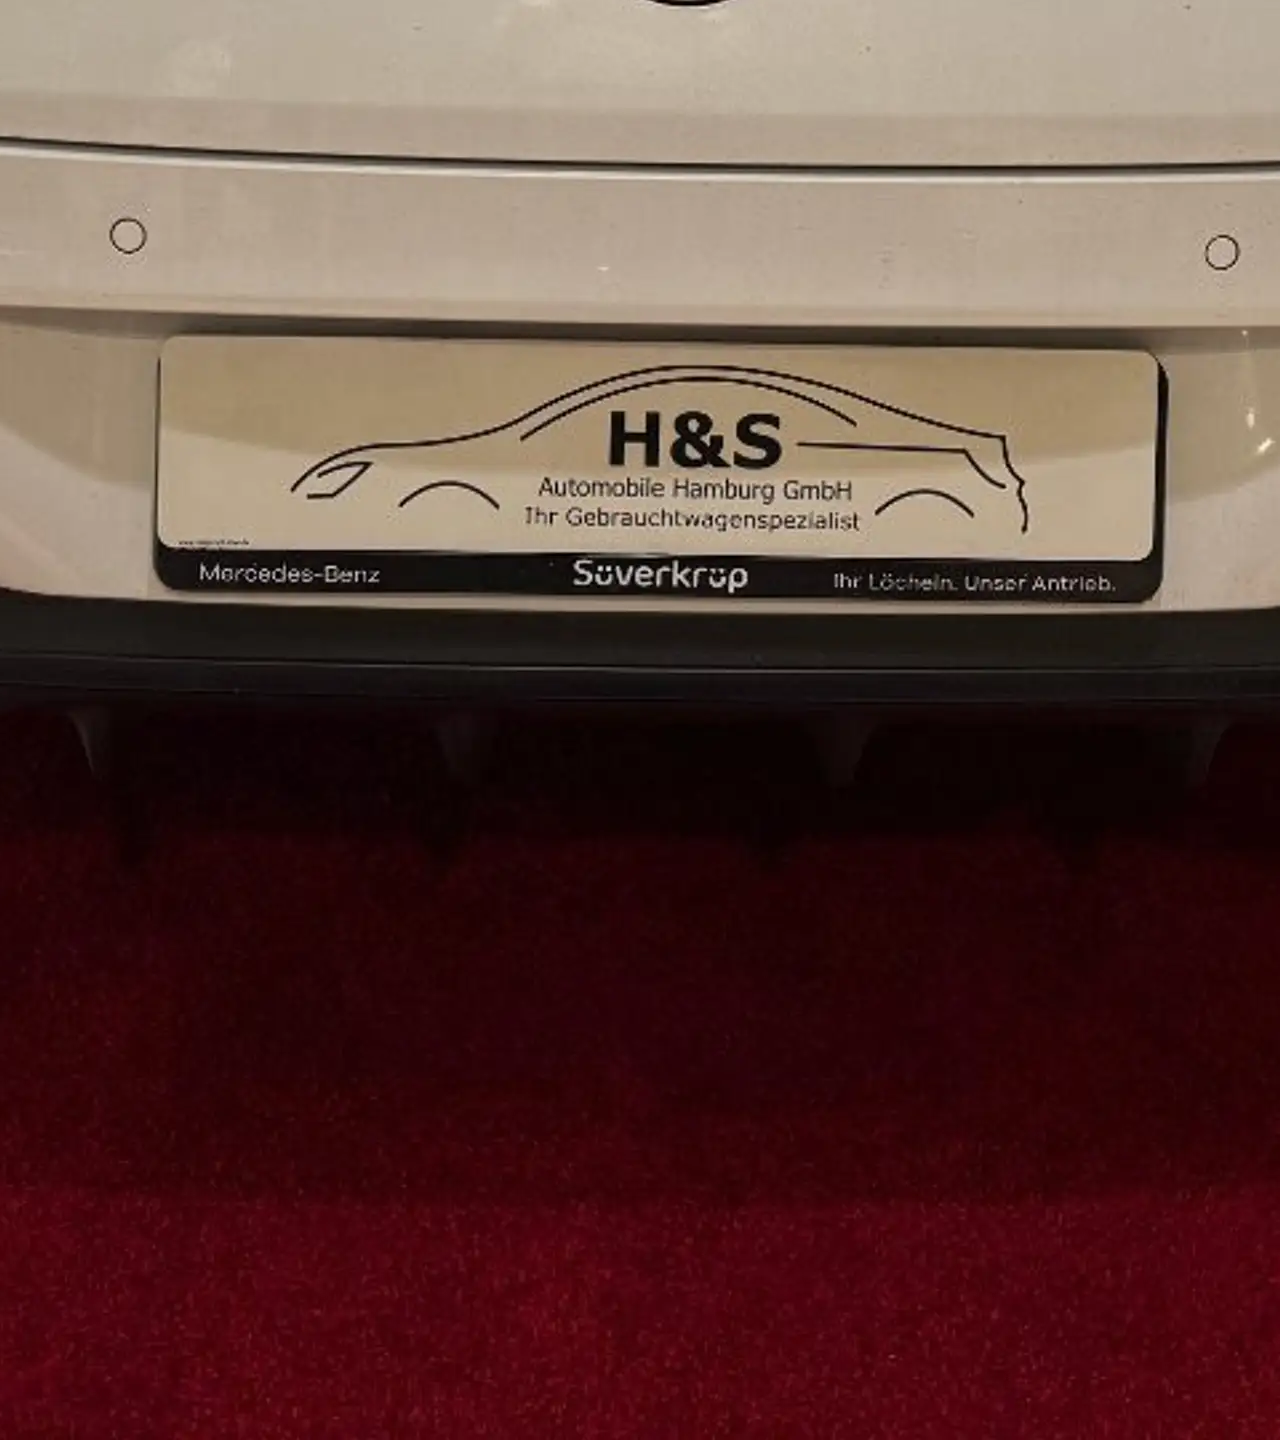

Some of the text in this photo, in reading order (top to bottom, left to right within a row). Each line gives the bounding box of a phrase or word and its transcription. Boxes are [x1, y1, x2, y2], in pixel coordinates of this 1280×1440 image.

[609, 410, 783, 469] H&S
[538, 477, 852, 505] Automobile Hamburg GmbH
[525, 507, 861, 532] Ihr Gebrauchtwagenspezialist
[199, 562, 380, 584] Mercedes-Benz
[573, 559, 748, 594] Süverkrüp
[833, 572, 860, 590] Ihr
[964, 574, 1026, 592] Unser
[1031, 575, 1117, 593] Antrieb.
